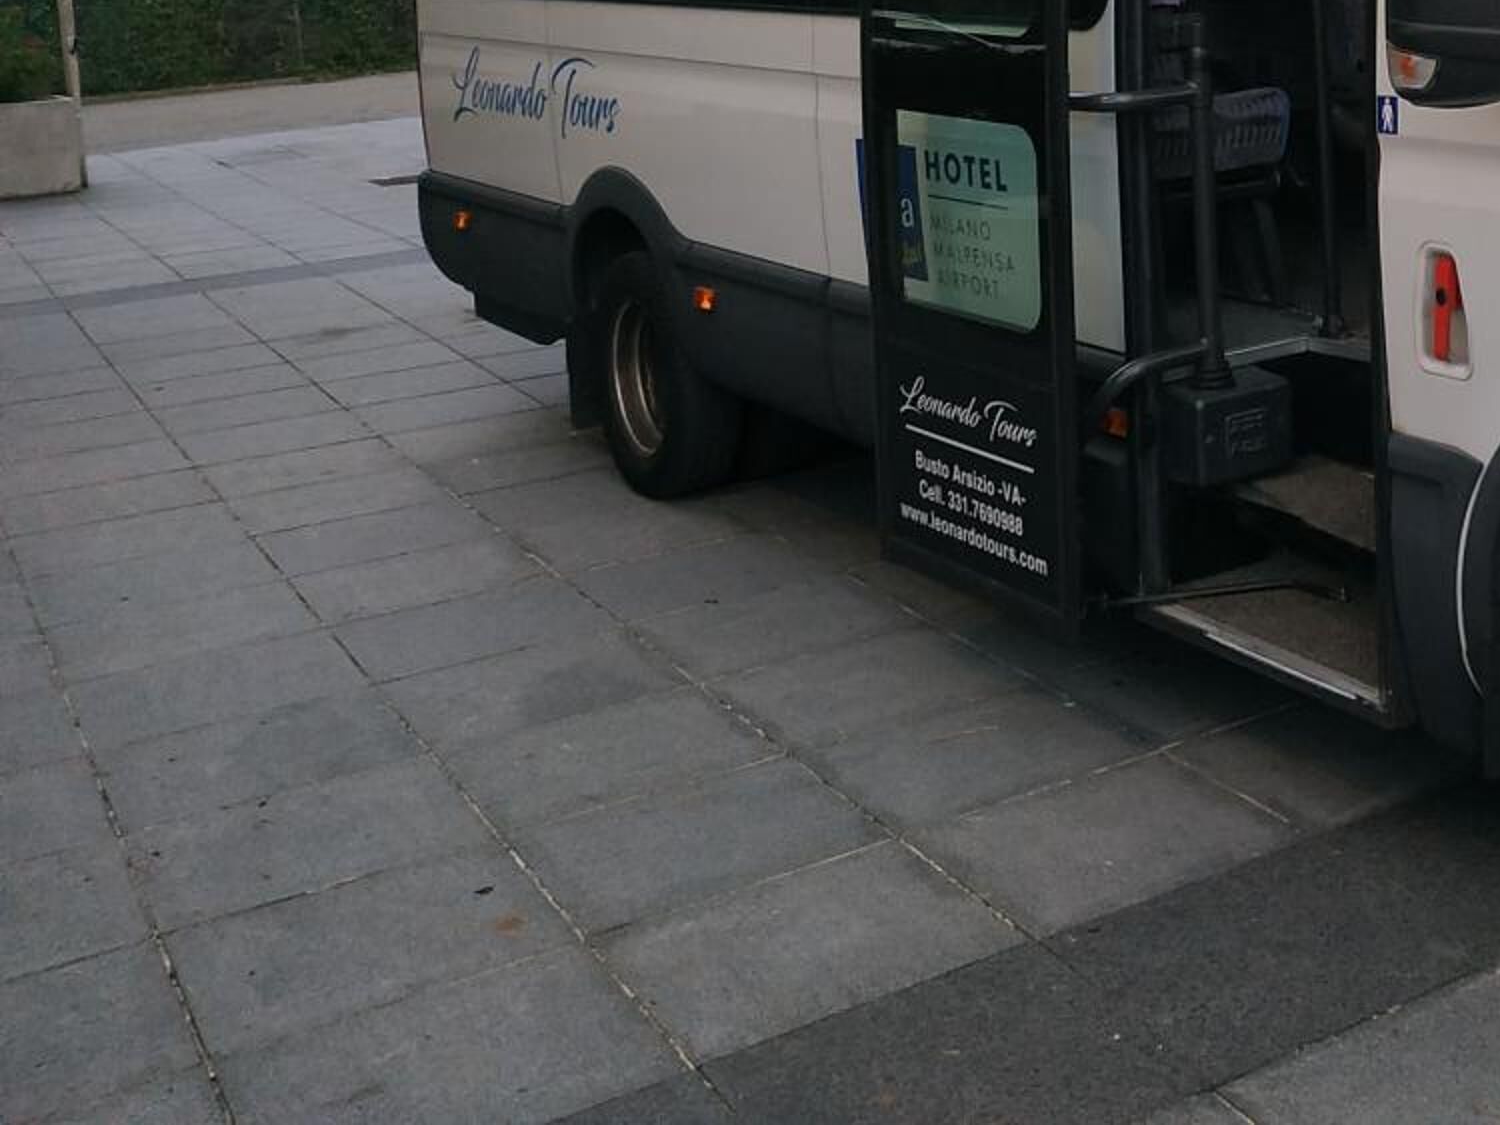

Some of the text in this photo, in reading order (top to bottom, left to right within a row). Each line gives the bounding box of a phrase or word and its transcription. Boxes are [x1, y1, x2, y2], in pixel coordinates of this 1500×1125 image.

[451, 45, 621, 139] Leonardo Tours
[923, 149, 1008, 192] HOTEL
[899, 375, 1038, 447] Leonardo Tours
[915, 450, 949, 479] Busto
[952, 464, 995, 496] Arsizio
[900, 502, 1048, 575] www.leonardotours.com
